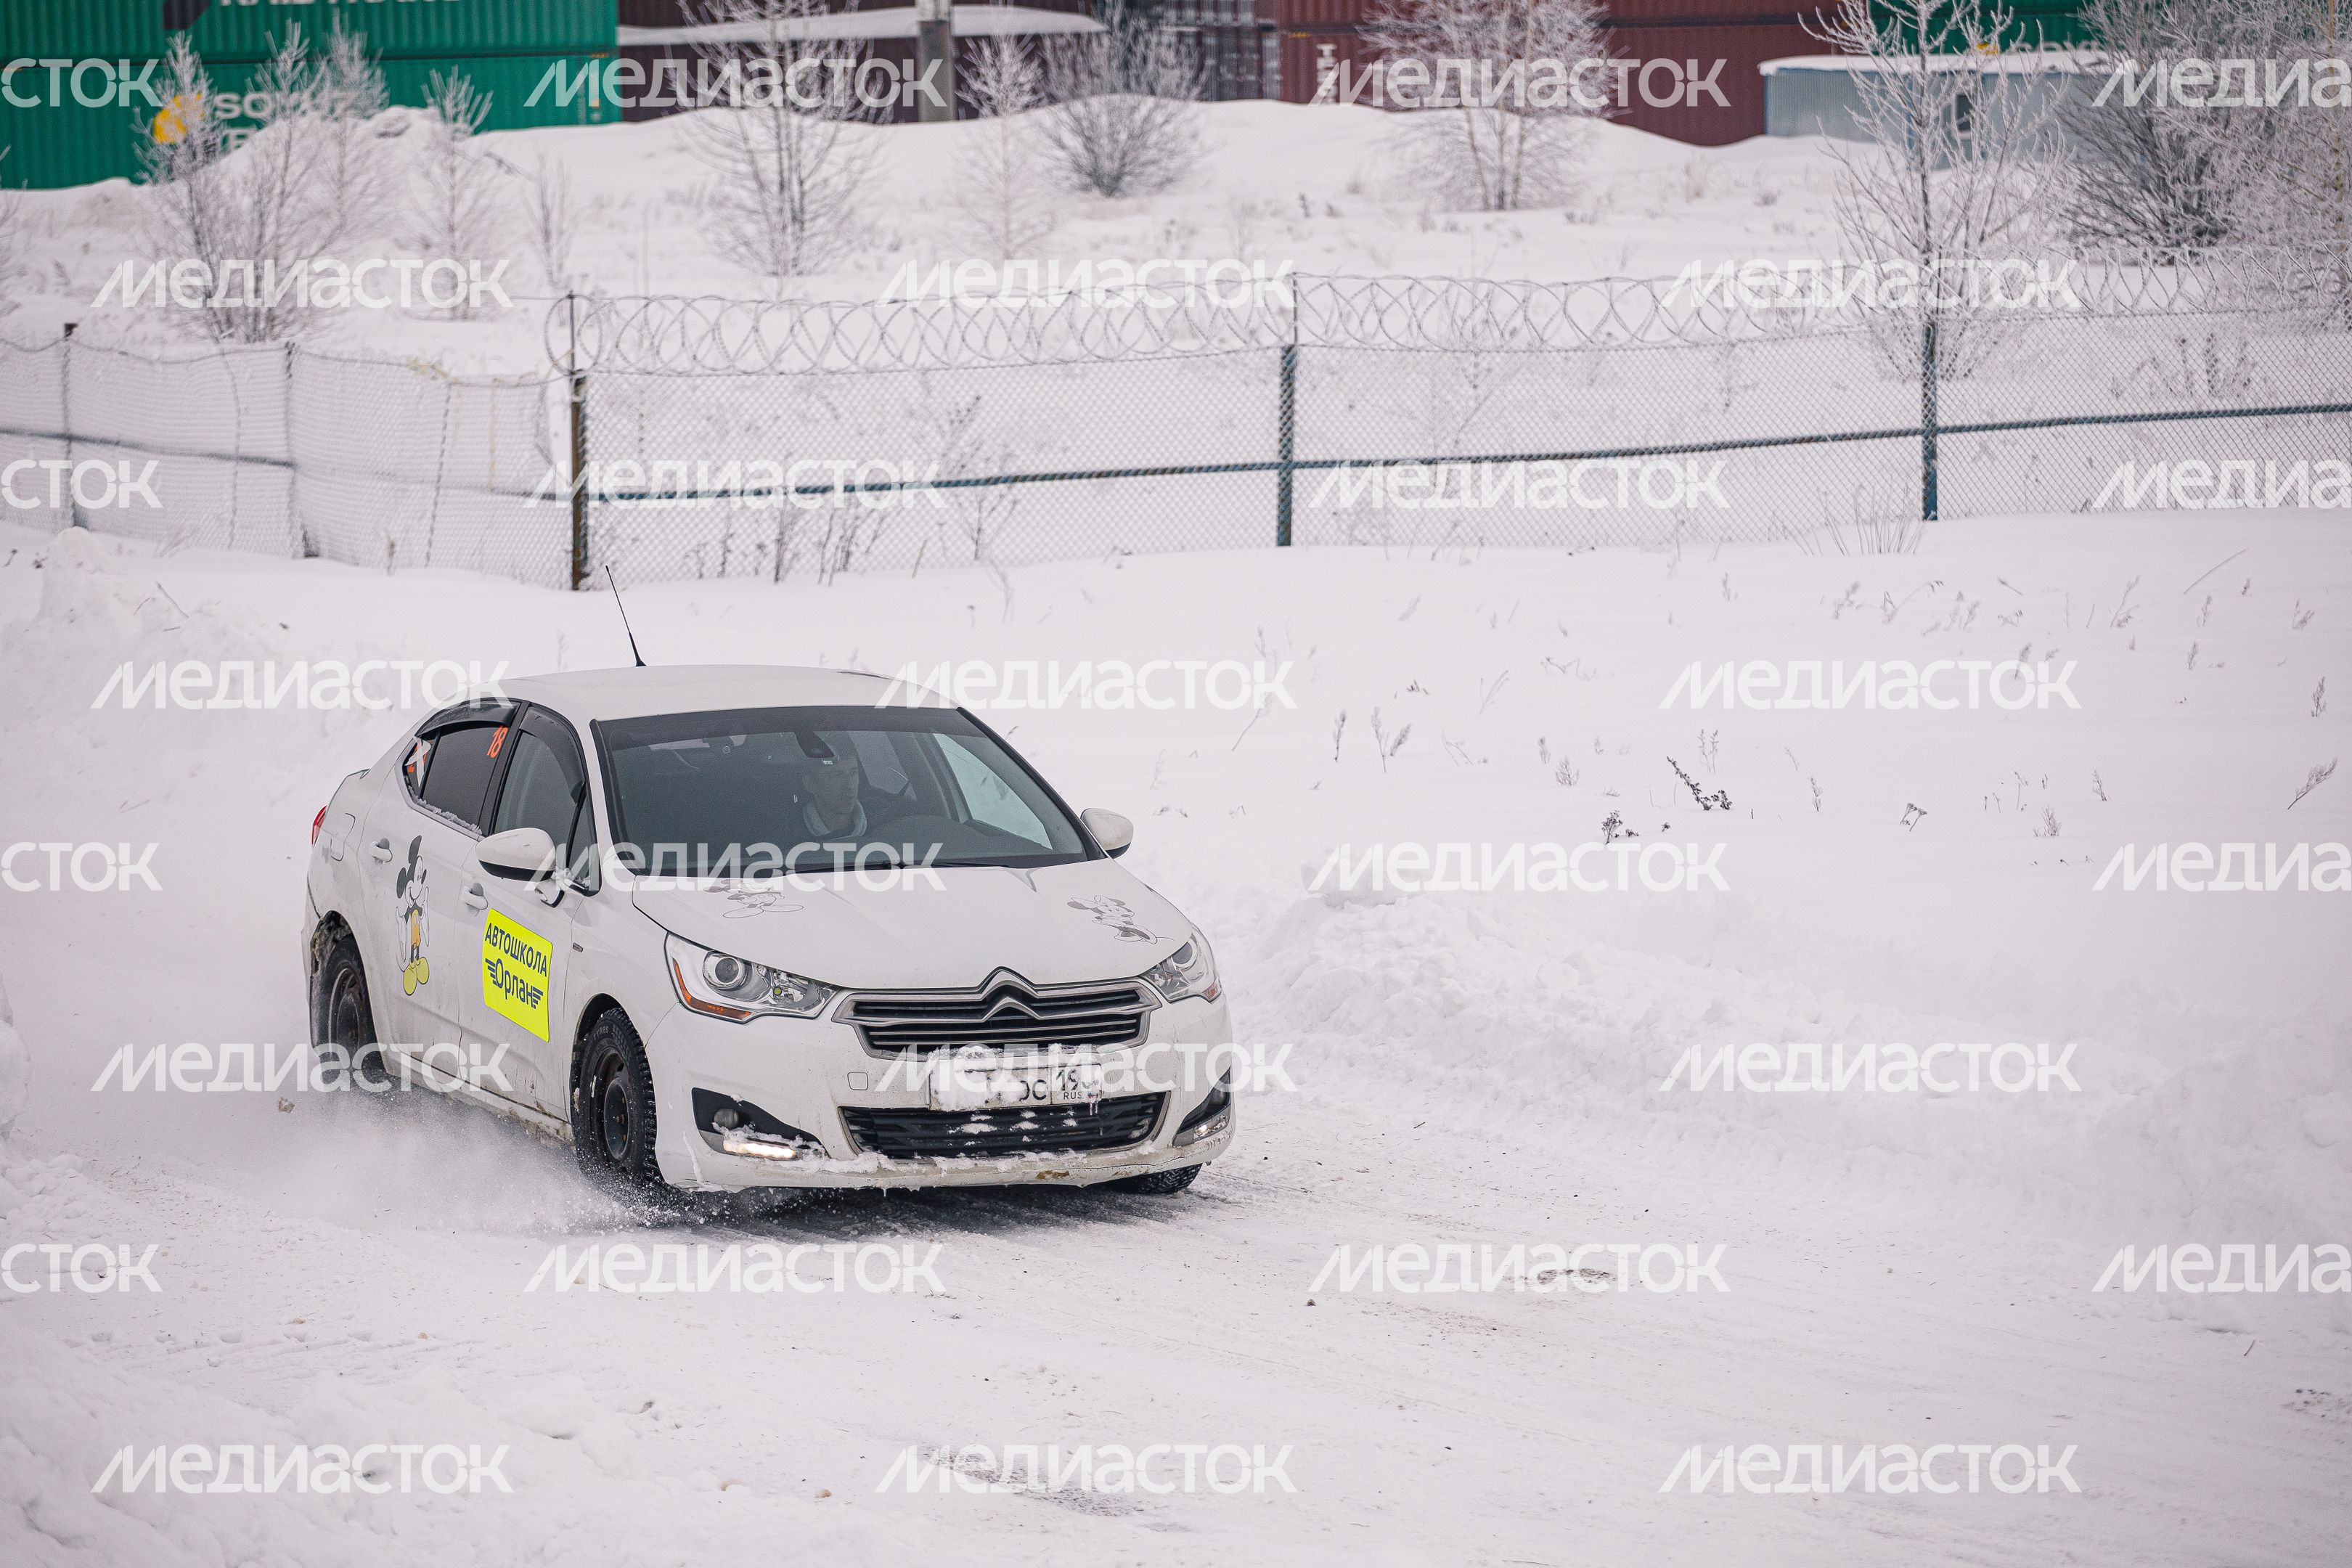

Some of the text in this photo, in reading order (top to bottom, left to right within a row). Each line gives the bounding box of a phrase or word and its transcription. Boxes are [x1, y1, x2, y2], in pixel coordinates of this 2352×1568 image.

[487, 725, 508, 758] 18
[484, 923, 547, 977] АВТОШКОЛА
[494, 958, 534, 1008] Орлан
